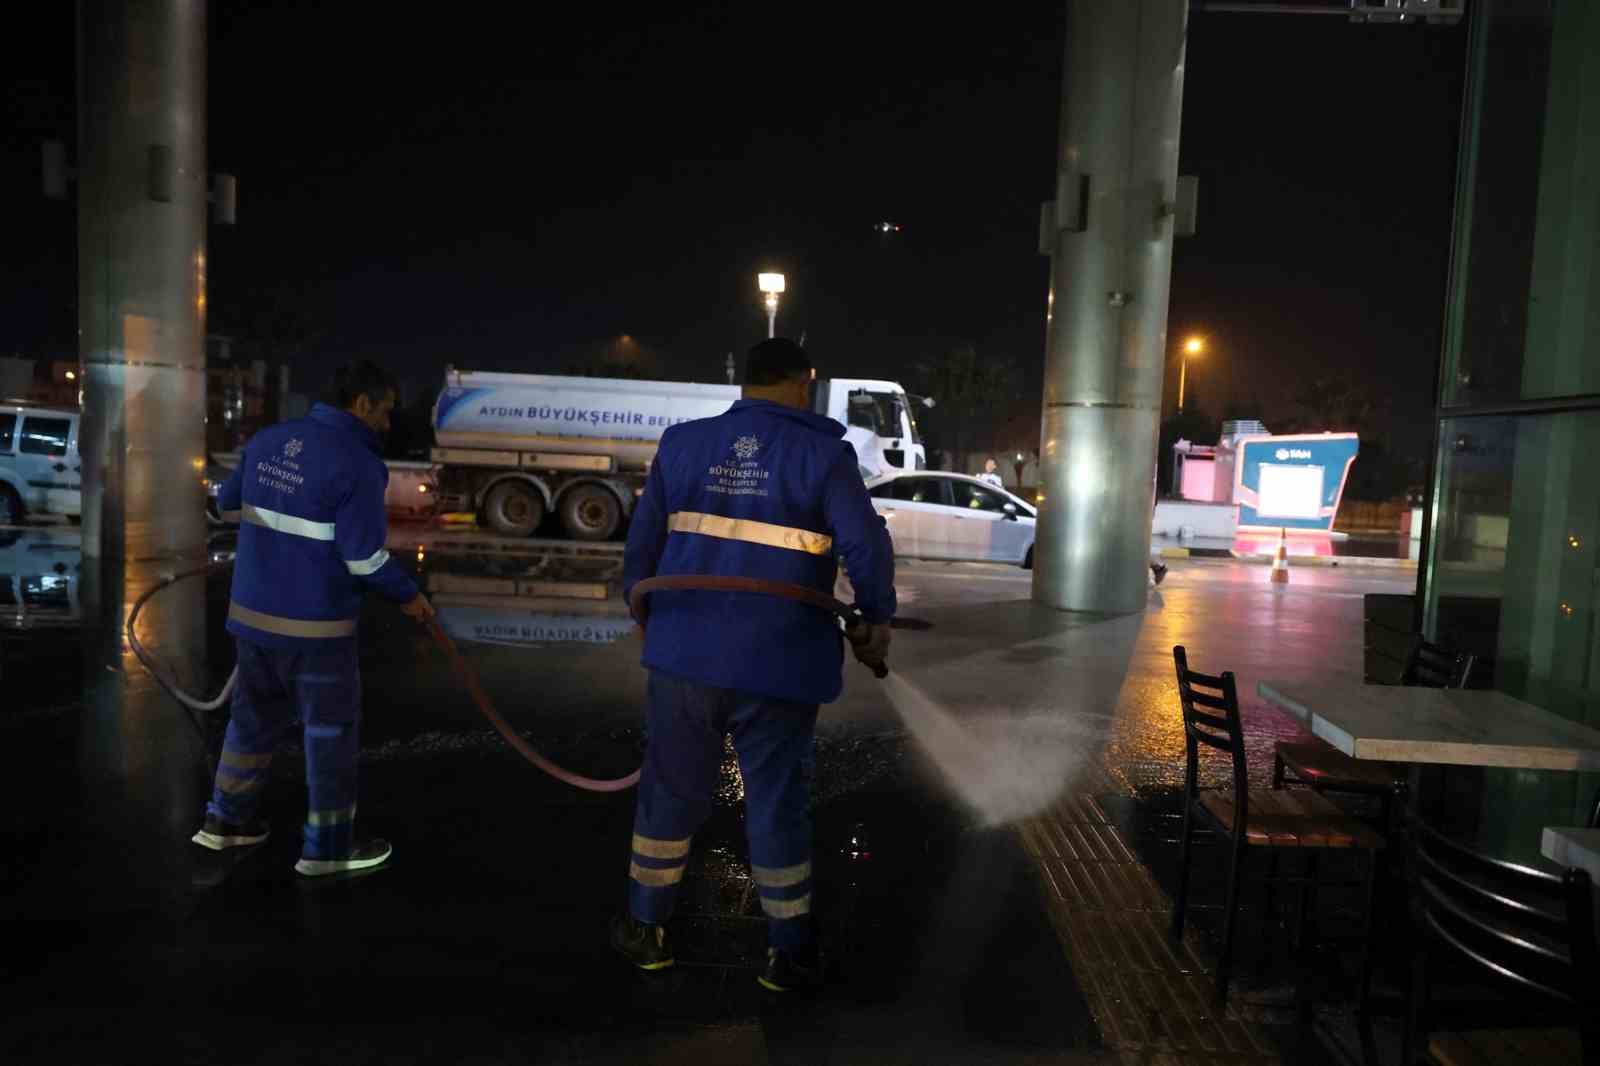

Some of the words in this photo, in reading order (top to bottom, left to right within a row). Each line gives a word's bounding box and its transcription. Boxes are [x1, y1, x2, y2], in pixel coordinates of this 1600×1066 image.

[479, 405, 524, 418] AYDIN
[527, 405, 644, 427] BÜYÜKŞEHİR
[257, 461, 304, 484] BÜYÜKŞEHİR
[708, 464, 769, 480] BÜYÜKŞEHİR
